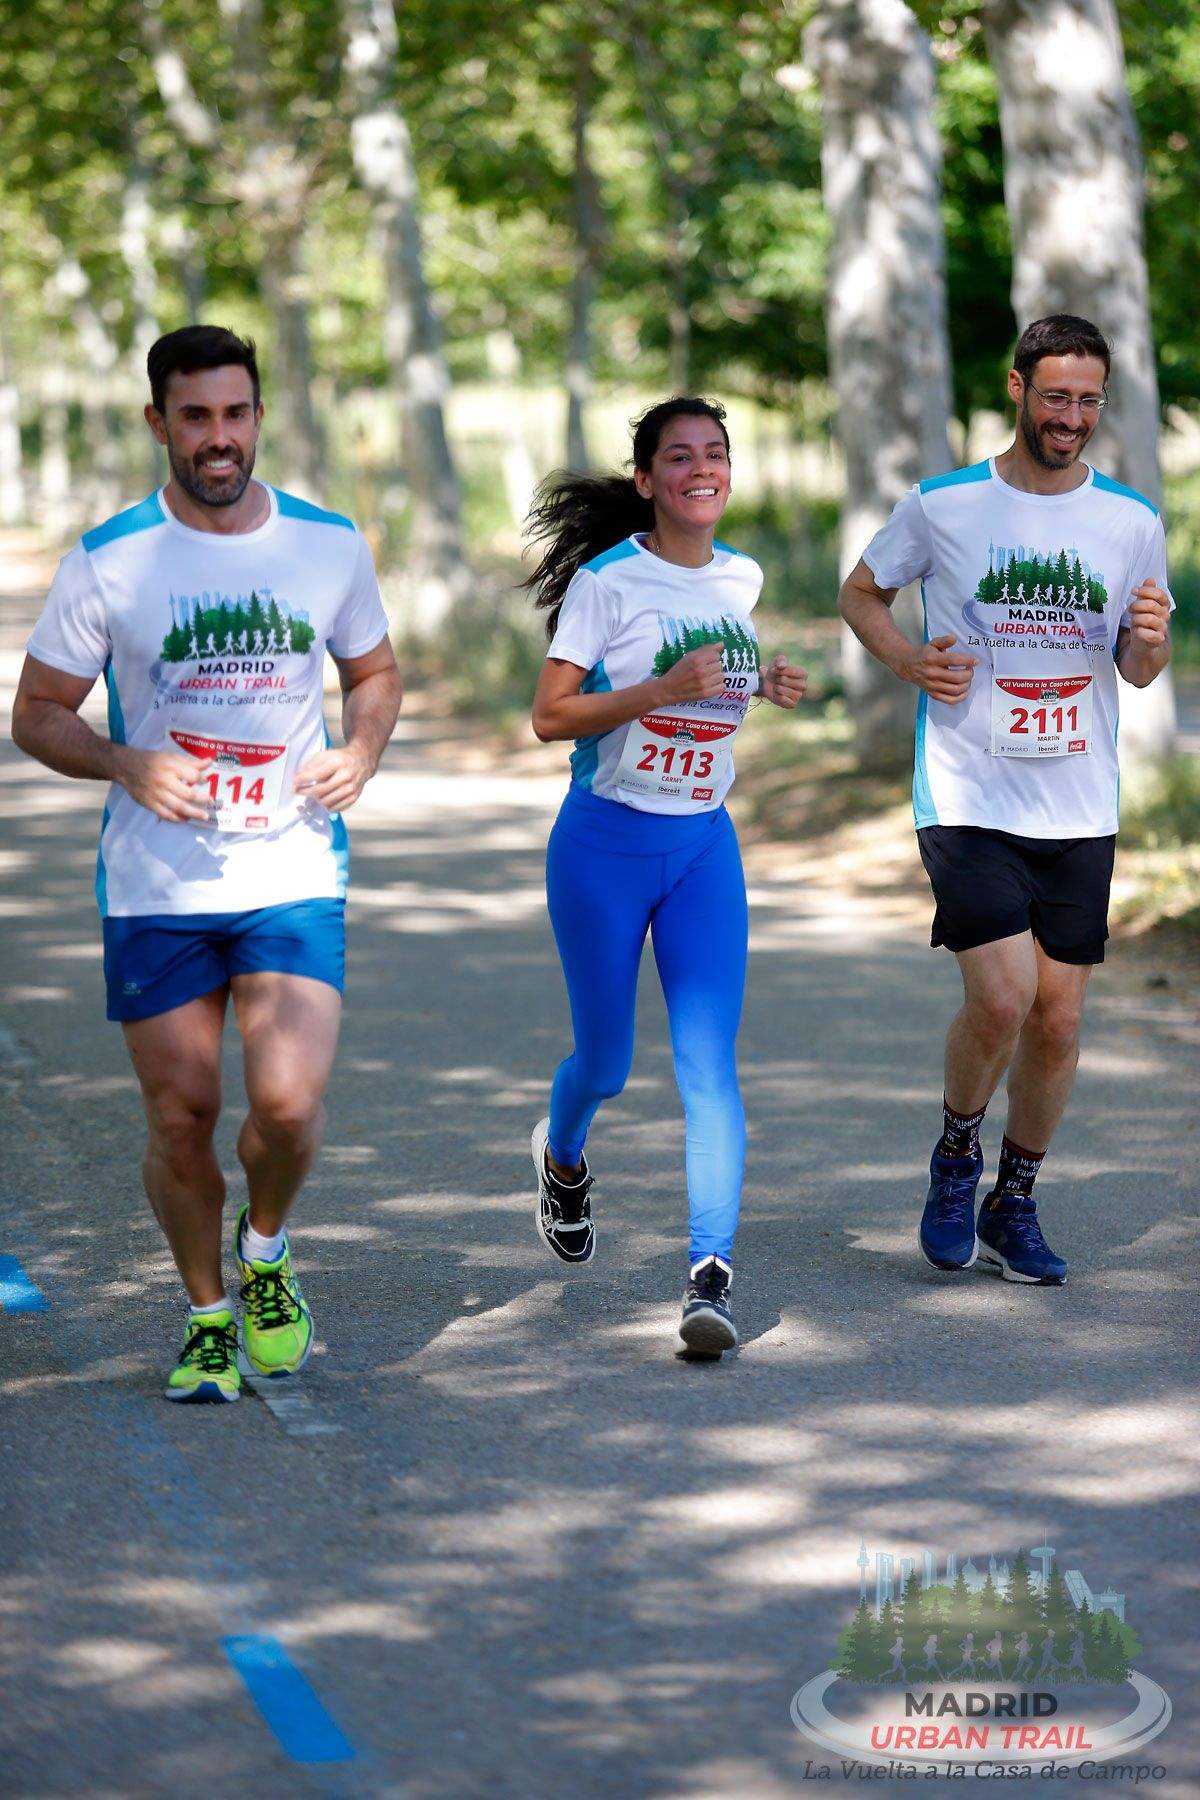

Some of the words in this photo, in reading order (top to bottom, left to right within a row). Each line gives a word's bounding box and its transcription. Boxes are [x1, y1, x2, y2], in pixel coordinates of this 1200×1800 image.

[1008, 608, 1076, 622] MADRID
[993, 622, 1047, 635] URBAN
[1051, 625, 1086, 638] TRAIL
[967, 636, 980, 646] La
[983, 637, 1016, 648] Vuelta
[1028, 639, 1037, 648] la
[1040, 640, 1067, 649] Casa
[1068, 640, 1080, 649] de
[198, 661, 275, 675] MADRID
[179, 677, 238, 690] URBAN
[243, 676, 287, 690] TRAIL
[723, 677, 748, 689] RID
[1070, 679, 1089, 687] Campo
[212, 694, 223, 706] la
[227, 695, 255, 706] Casa
[259, 693, 275, 705] de
[718, 691, 748, 703] TRAI
[699, 701, 725, 710] Casa
[724, 703, 738, 711] de
[651, 717, 671, 725] Vuelta
[685, 722, 701, 730] Casa
[700, 723, 709, 731] de
[709, 724, 731, 733] Campo
[1009, 705, 1078, 734] 2111
[636, 743, 714, 779] 2113
[205, 772, 265, 806] 114
